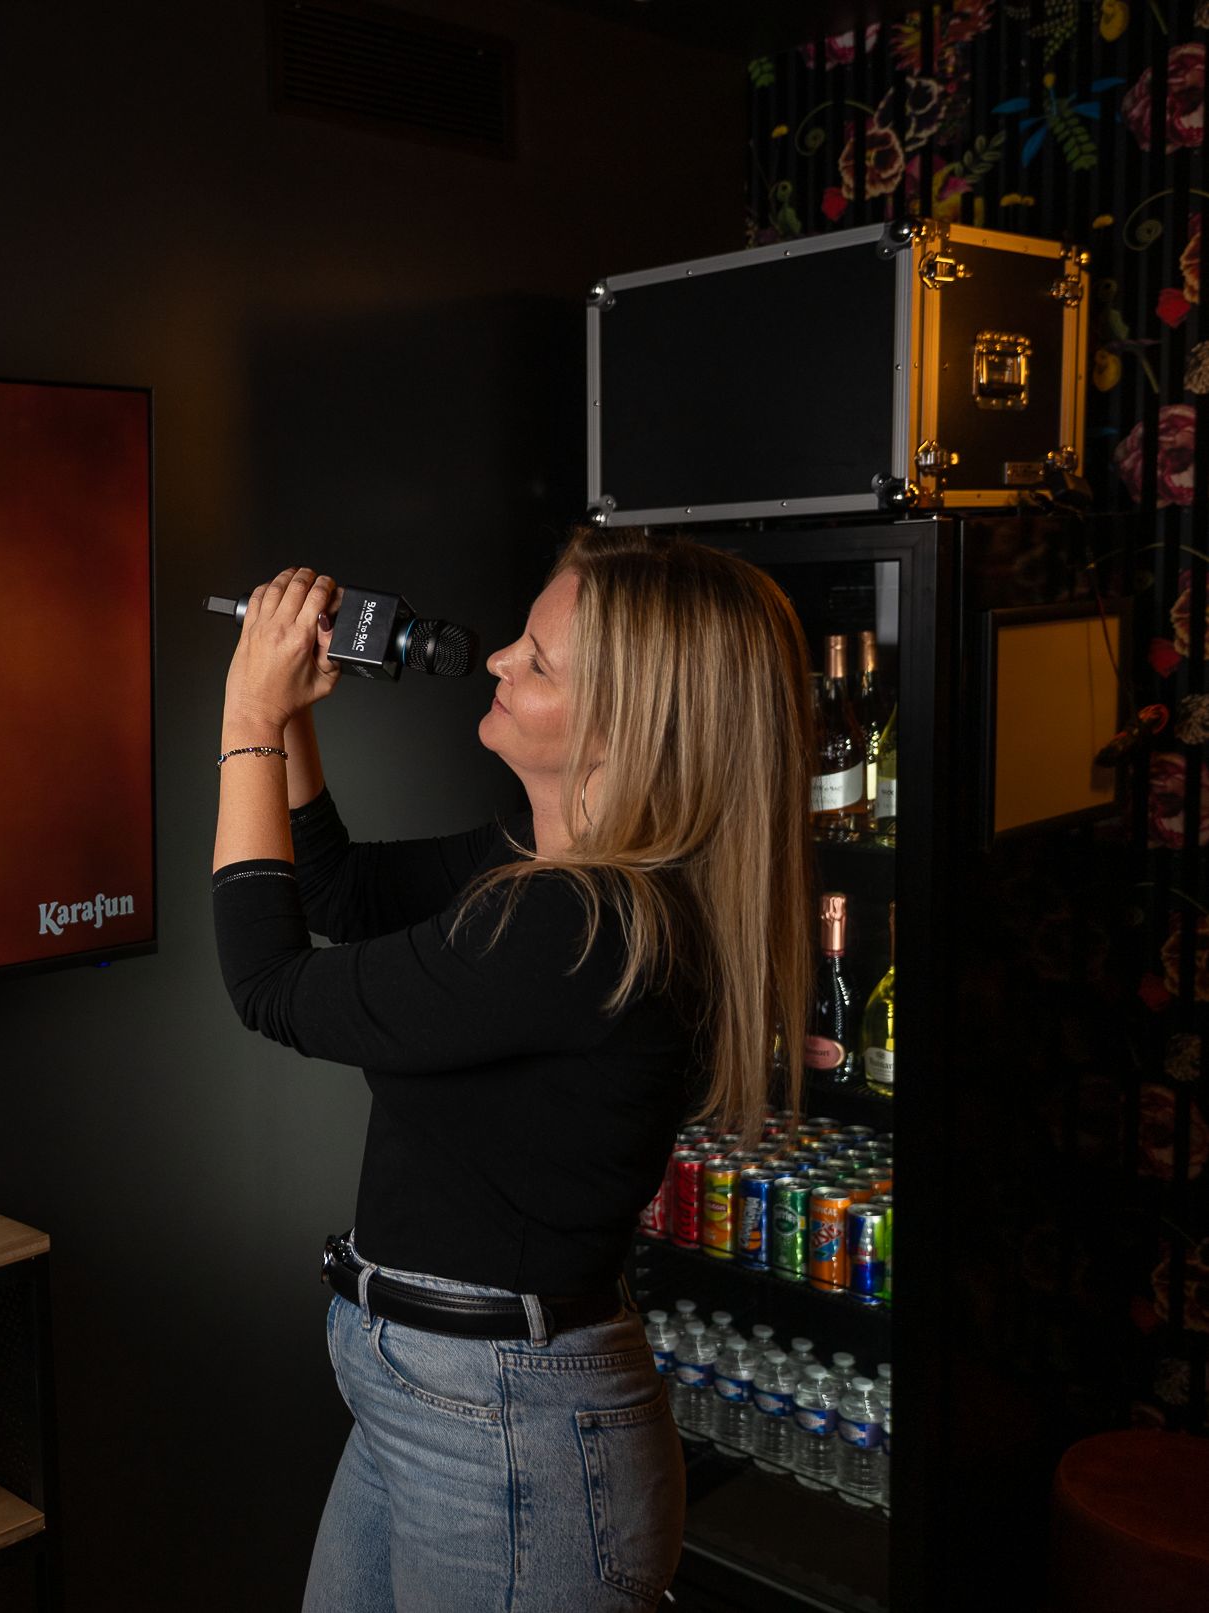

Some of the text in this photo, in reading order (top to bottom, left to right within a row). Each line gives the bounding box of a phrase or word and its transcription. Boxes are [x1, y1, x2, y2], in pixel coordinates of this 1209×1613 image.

[362, 601, 377, 626] BACK
[355, 633, 368, 652] BAC
[38, 893, 135, 936] Karafun
